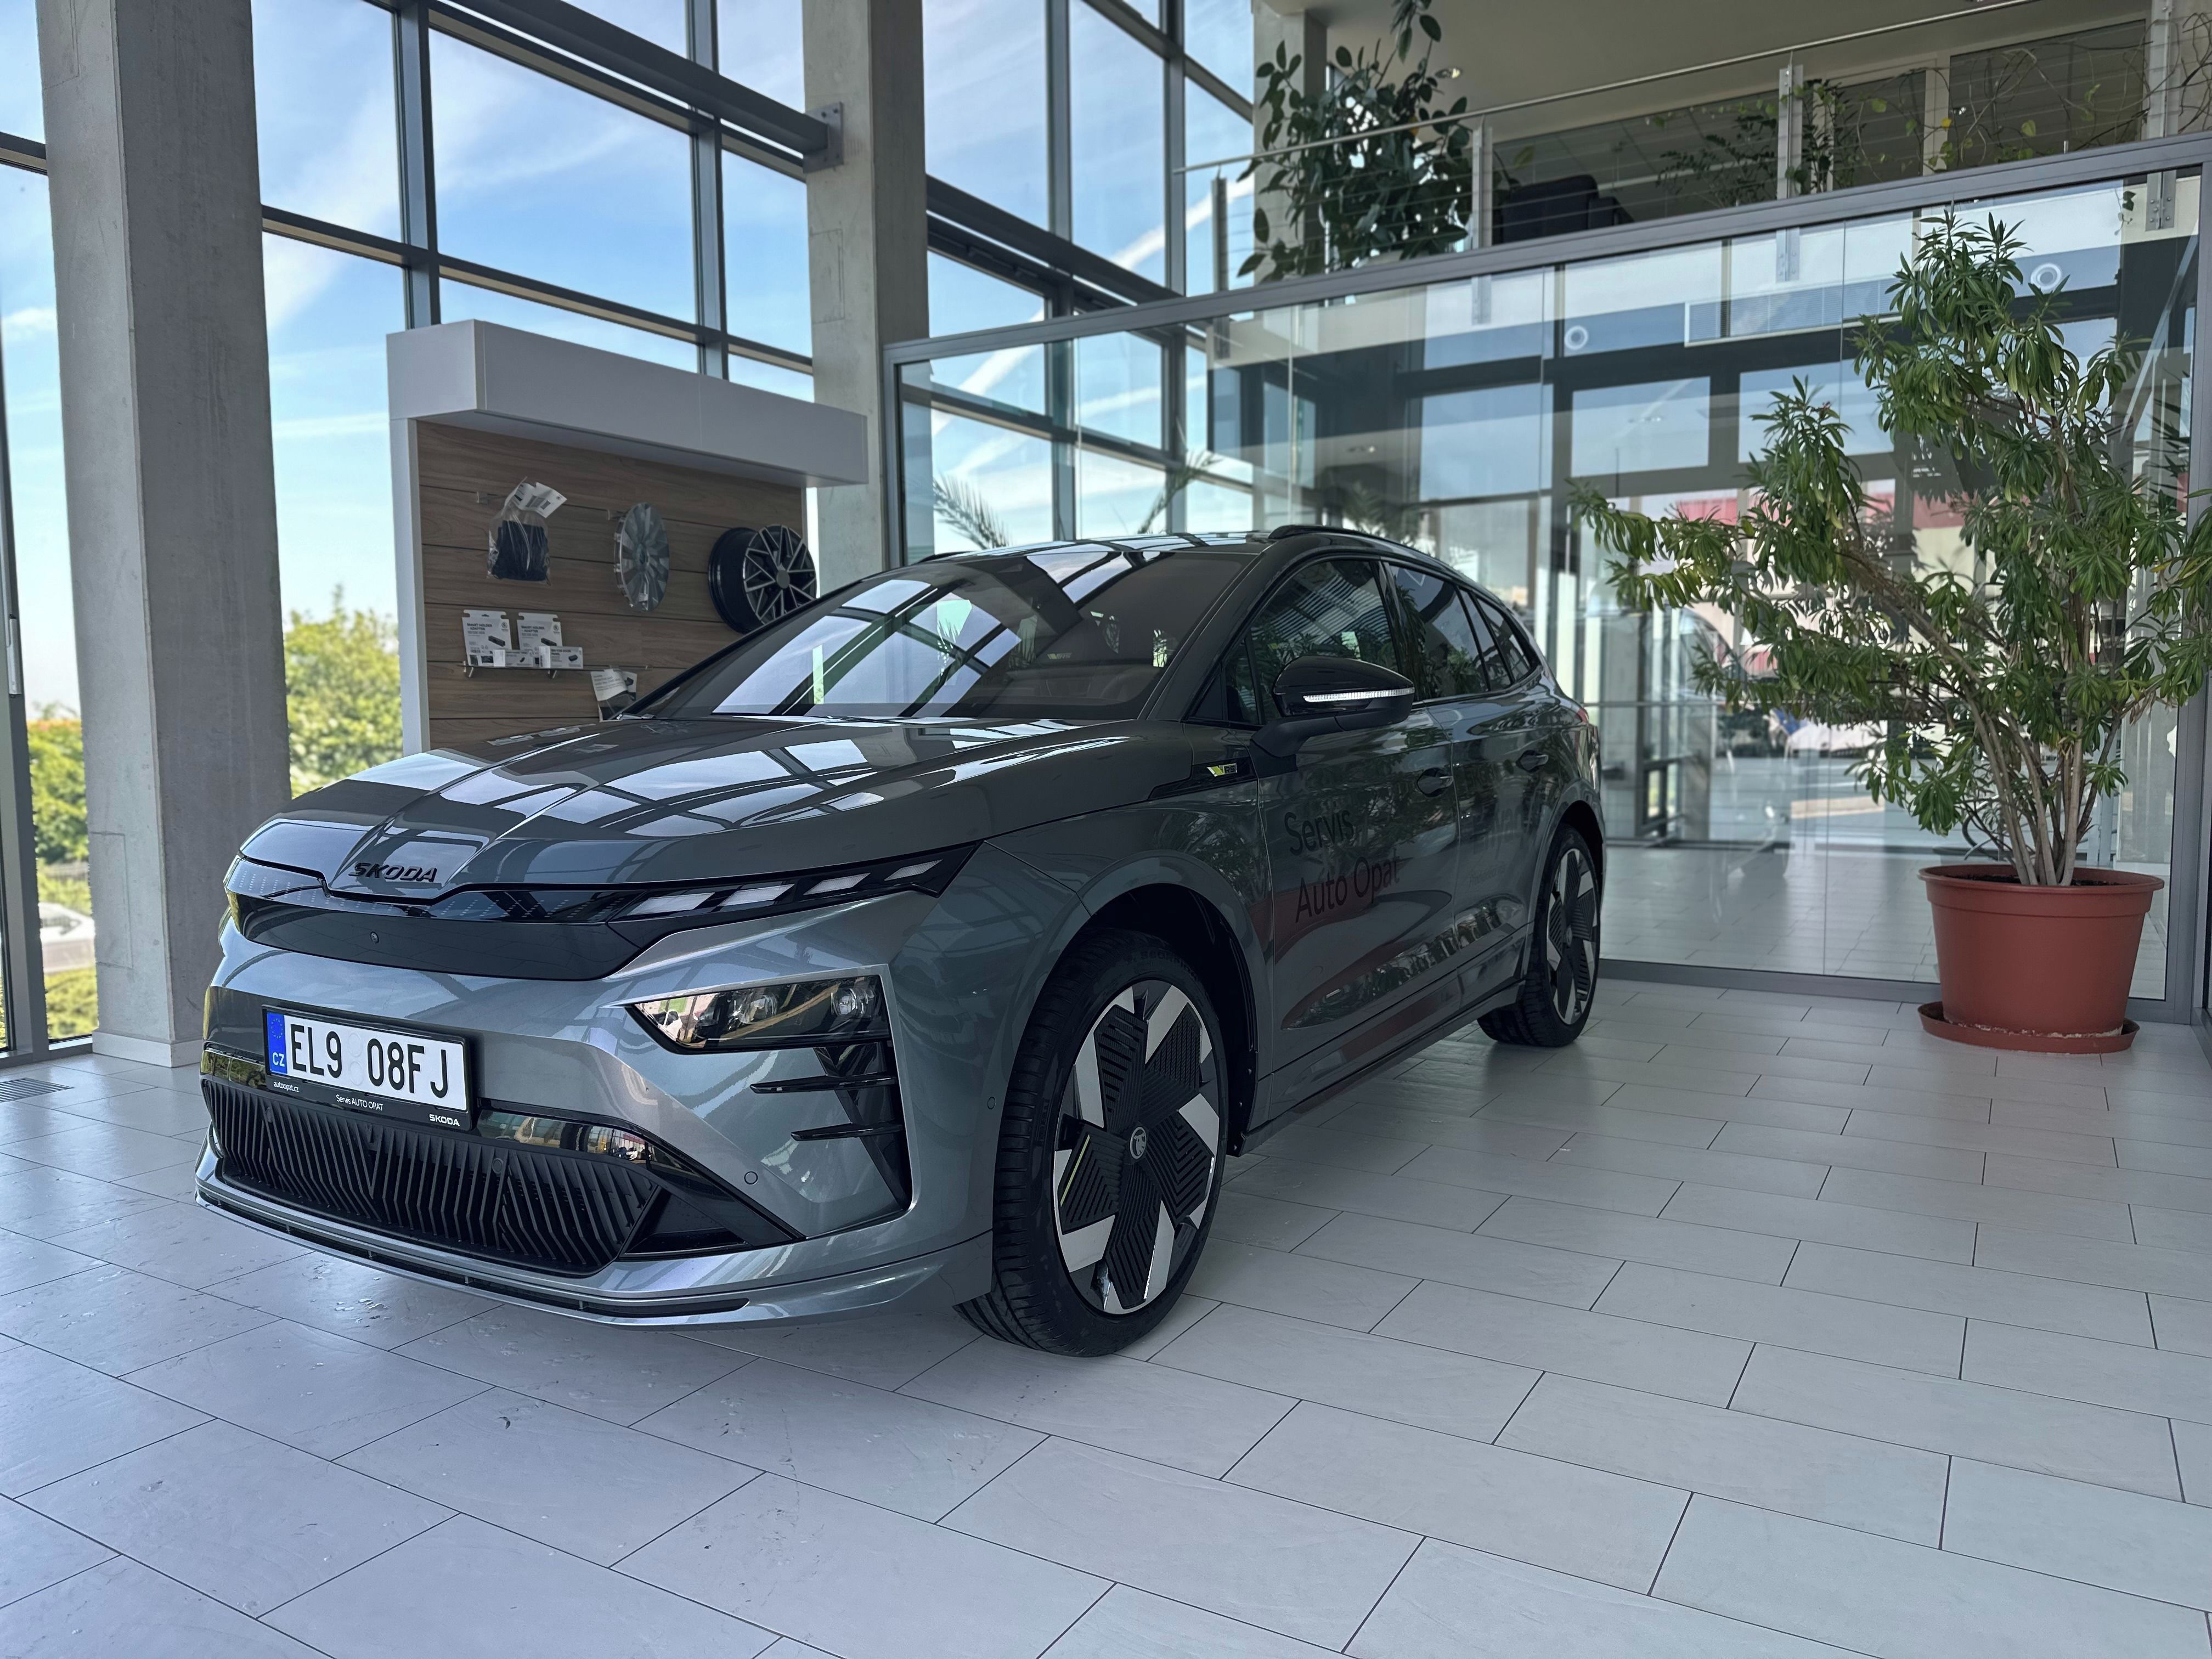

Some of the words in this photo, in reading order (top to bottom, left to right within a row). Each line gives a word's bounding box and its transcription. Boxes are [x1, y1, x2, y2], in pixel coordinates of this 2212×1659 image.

[1284, 809, 1354, 855] Servis
[1295, 871, 1347, 923] Auto
[1354, 848, 1400, 904] Opat
[272, 1052, 285, 1067] CZ
[290, 1024, 342, 1079] EL9
[366, 1038, 449, 1098] 08FJ
[274, 1081, 300, 1093] autoopat.cz
[336, 1094, 351, 1105] Servis
[352, 1098, 368, 1108] AUTO
[368, 1101, 383, 1111] OPAT
